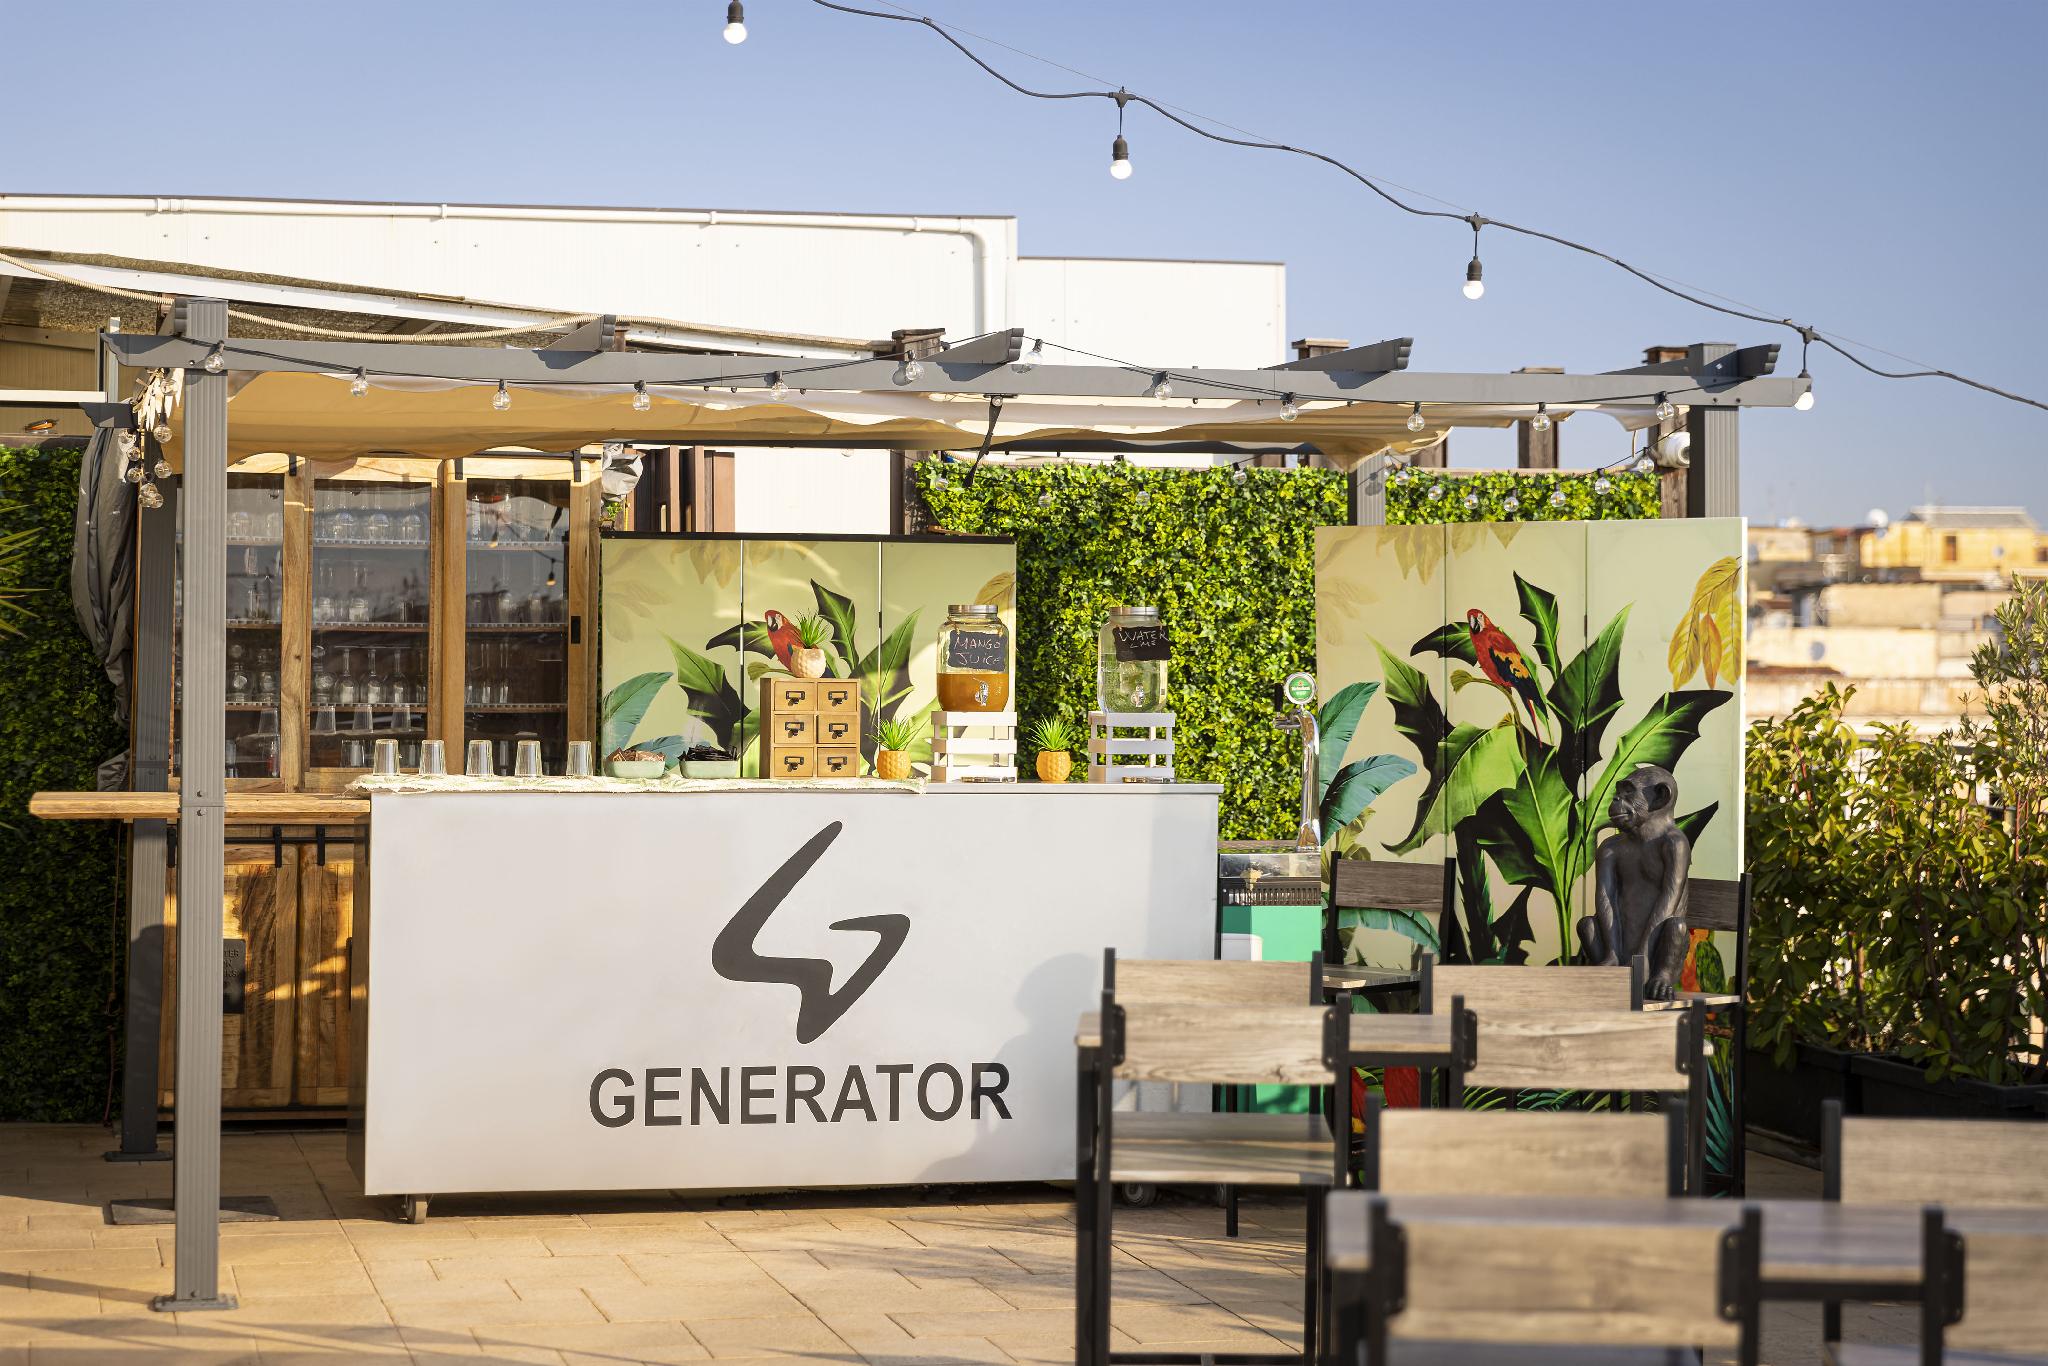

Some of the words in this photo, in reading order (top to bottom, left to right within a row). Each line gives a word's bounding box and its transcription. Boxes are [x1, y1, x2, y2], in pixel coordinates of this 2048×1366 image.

[953, 636, 1001, 650] MANGO
[1118, 630, 1169, 642] WATER
[589, 1062, 1013, 1128] GENERATOR
